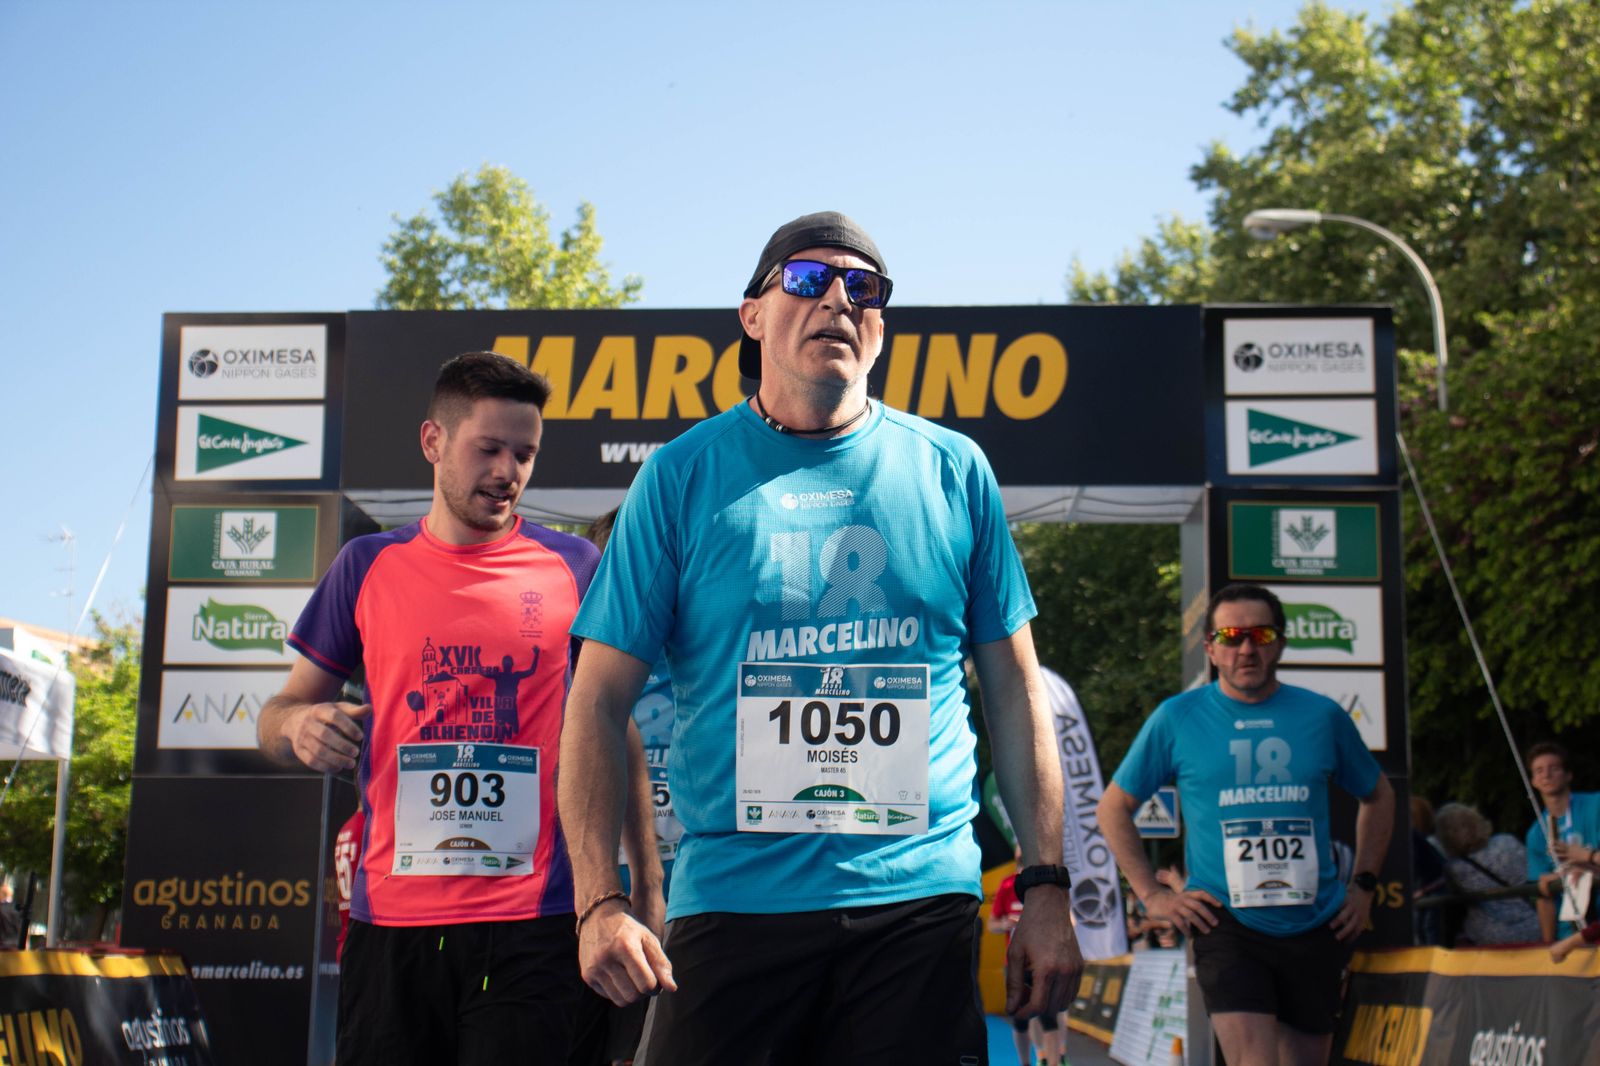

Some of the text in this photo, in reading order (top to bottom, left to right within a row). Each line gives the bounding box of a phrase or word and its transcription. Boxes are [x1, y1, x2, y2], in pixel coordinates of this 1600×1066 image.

[223, 349, 316, 364] OXIMESA
[1267, 343, 1364, 358] OXIMESA
[222, 368, 317, 379] NIPPON GASES
[491, 332, 1068, 420] MARCINO
[799, 489, 853, 501] OXIMESA
[212, 560, 274, 570] CAJA RURAL
[771, 524, 888, 620] 18
[193, 614, 287, 641] Natura
[1285, 617, 1355, 641] atura
[746, 617, 919, 661] MARCELINO
[757, 674, 792, 683] OXIMESA
[820, 667, 845, 685] 18
[886, 676, 923, 685] OXIMESA
[815, 688, 851, 696] MARCELINO
[768, 700, 900, 747] 1050
[457, 744, 475, 759] 18
[806, 747, 859, 763] MOISÉS
[1229, 737, 1292, 785] 18
[430, 772, 505, 808] 903
[814, 788, 838, 797] CAJÓN
[1218, 786, 1310, 807] MARCELINO
[430, 811, 503, 822] JOSE MANUEL
[450, 839, 469, 848] CAJÓN
[1238, 838, 1305, 862] 2102
[133, 871, 310, 916] agustinos
[161, 915, 279, 930] GRANADA
[192, 961, 304, 979] omarcelino.es
